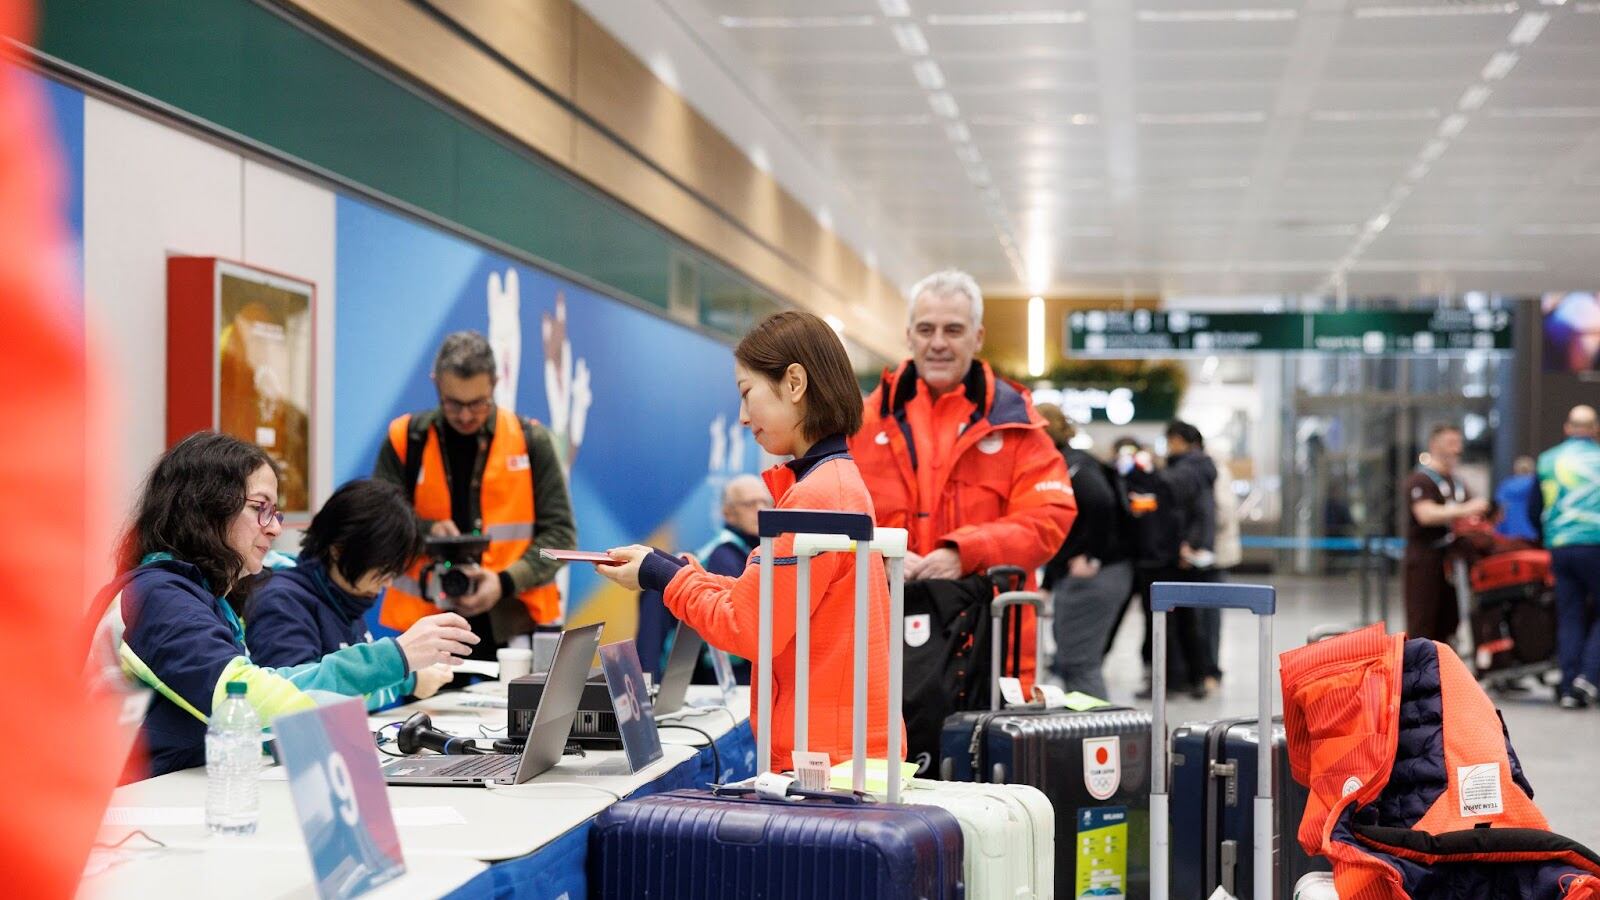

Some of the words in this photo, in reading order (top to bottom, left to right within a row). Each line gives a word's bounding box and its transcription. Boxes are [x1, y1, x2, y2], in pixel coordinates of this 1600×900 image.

[624, 673, 641, 721] 8
[328, 751, 360, 827] 9
[1463, 803, 1482, 811] JAPAN
